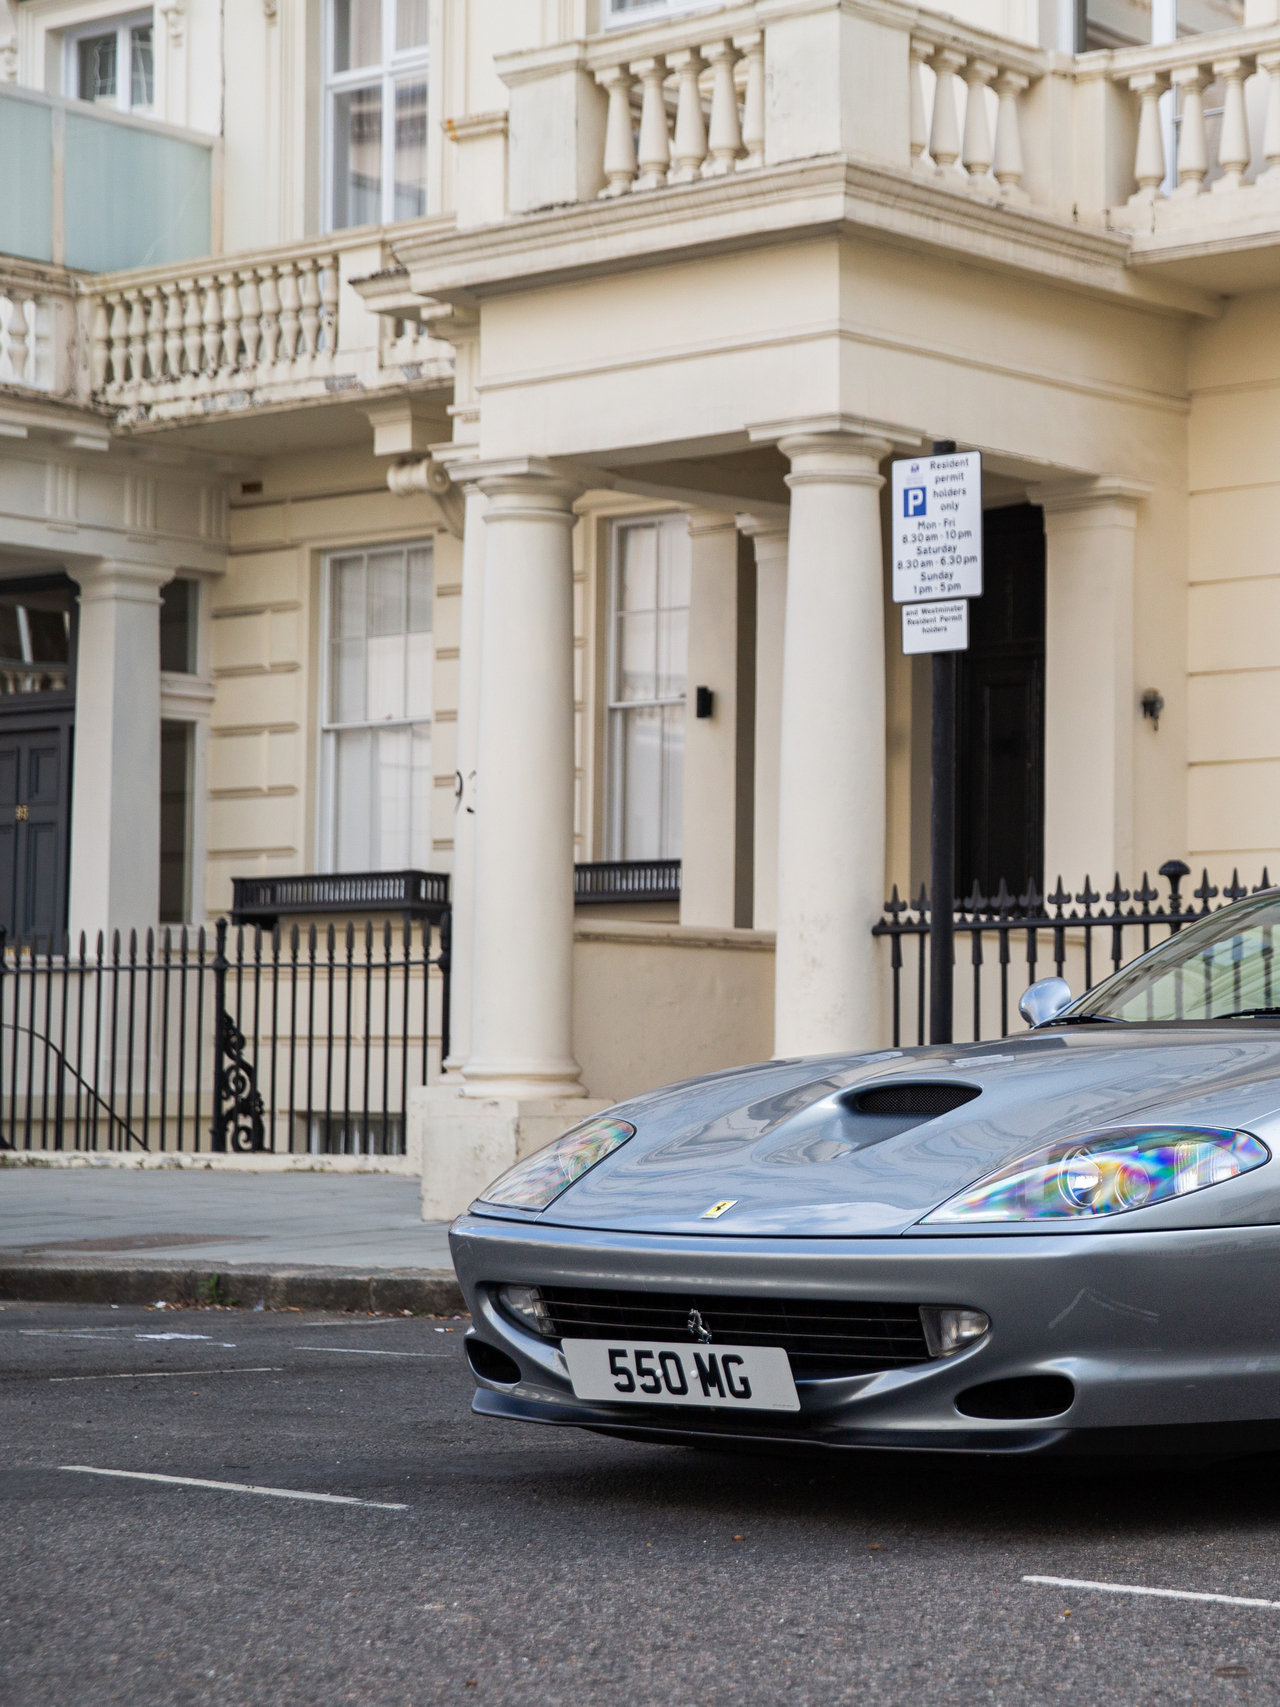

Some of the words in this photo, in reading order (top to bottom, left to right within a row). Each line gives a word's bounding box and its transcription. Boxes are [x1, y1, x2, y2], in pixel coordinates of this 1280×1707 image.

[930, 457, 969, 470] Resident
[935, 472, 964, 484] permit
[933, 488, 967, 498] holders
[908, 489, 924, 516] P
[940, 501, 960, 511] only
[917, 521, 937, 530] Mon
[943, 517, 956, 527] Fri
[916, 543, 957, 556] Saturday
[920, 570, 954, 581] Sunday
[905, 608, 919, 616] and
[921, 605, 964, 615] Westminster
[907, 617, 937, 625] Resident
[940, 614, 963, 622] Permit
[922, 625, 948, 634] holders
[608, 1348, 689, 1396] 550
[693, 1352, 753, 1400] MG
